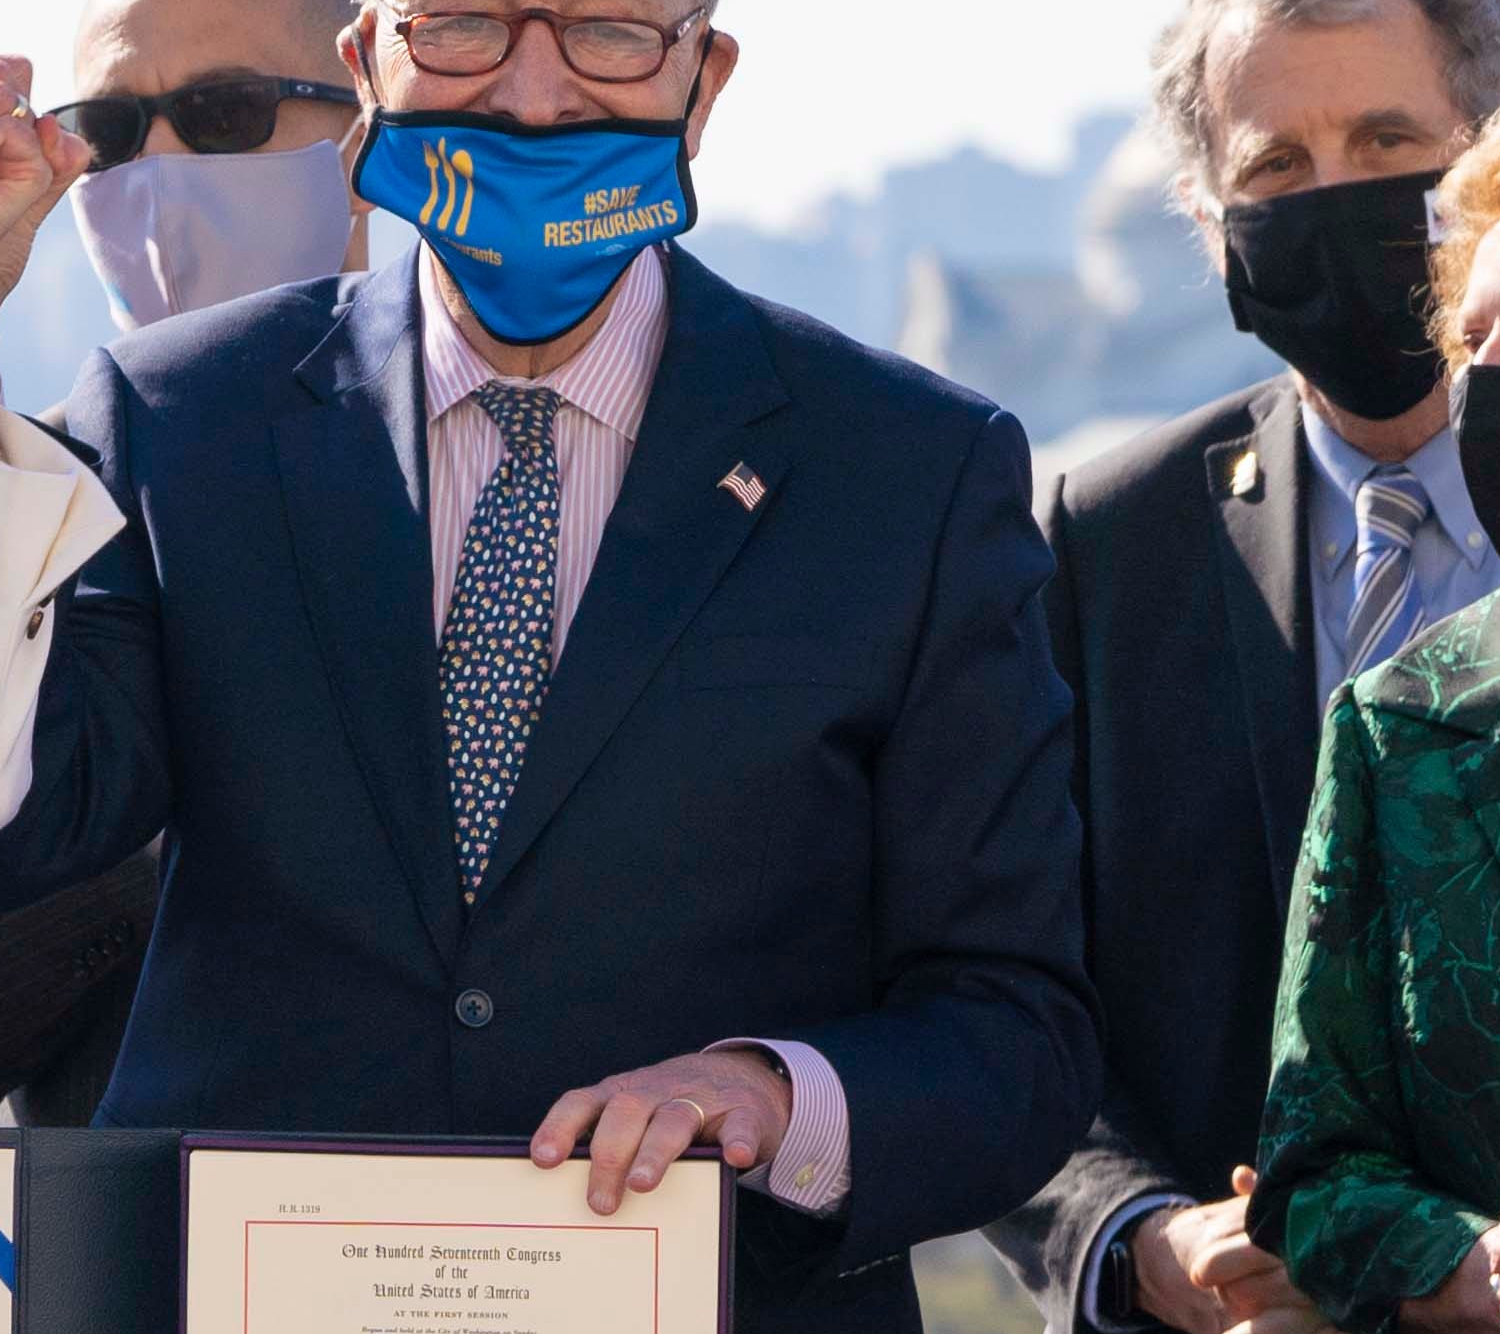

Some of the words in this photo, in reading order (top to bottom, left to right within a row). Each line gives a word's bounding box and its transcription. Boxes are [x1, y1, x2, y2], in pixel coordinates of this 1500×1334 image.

[584, 184, 642, 215] #SAVE
[544, 200, 678, 247] RESTAURANTS
[301, 1204, 320, 1213] 1319
[342, 1243, 367, 1258] One
[375, 1244, 423, 1259] Hundred
[430, 1245, 500, 1261] Seventeenth
[506, 1247, 560, 1265] Congress
[435, 1265, 444, 1279] of
[452, 1266, 467, 1279] the
[374, 1283, 413, 1297] United
[420, 1283, 460, 1299] States
[467, 1284, 476, 1299] of
[484, 1285, 529, 1299] America
